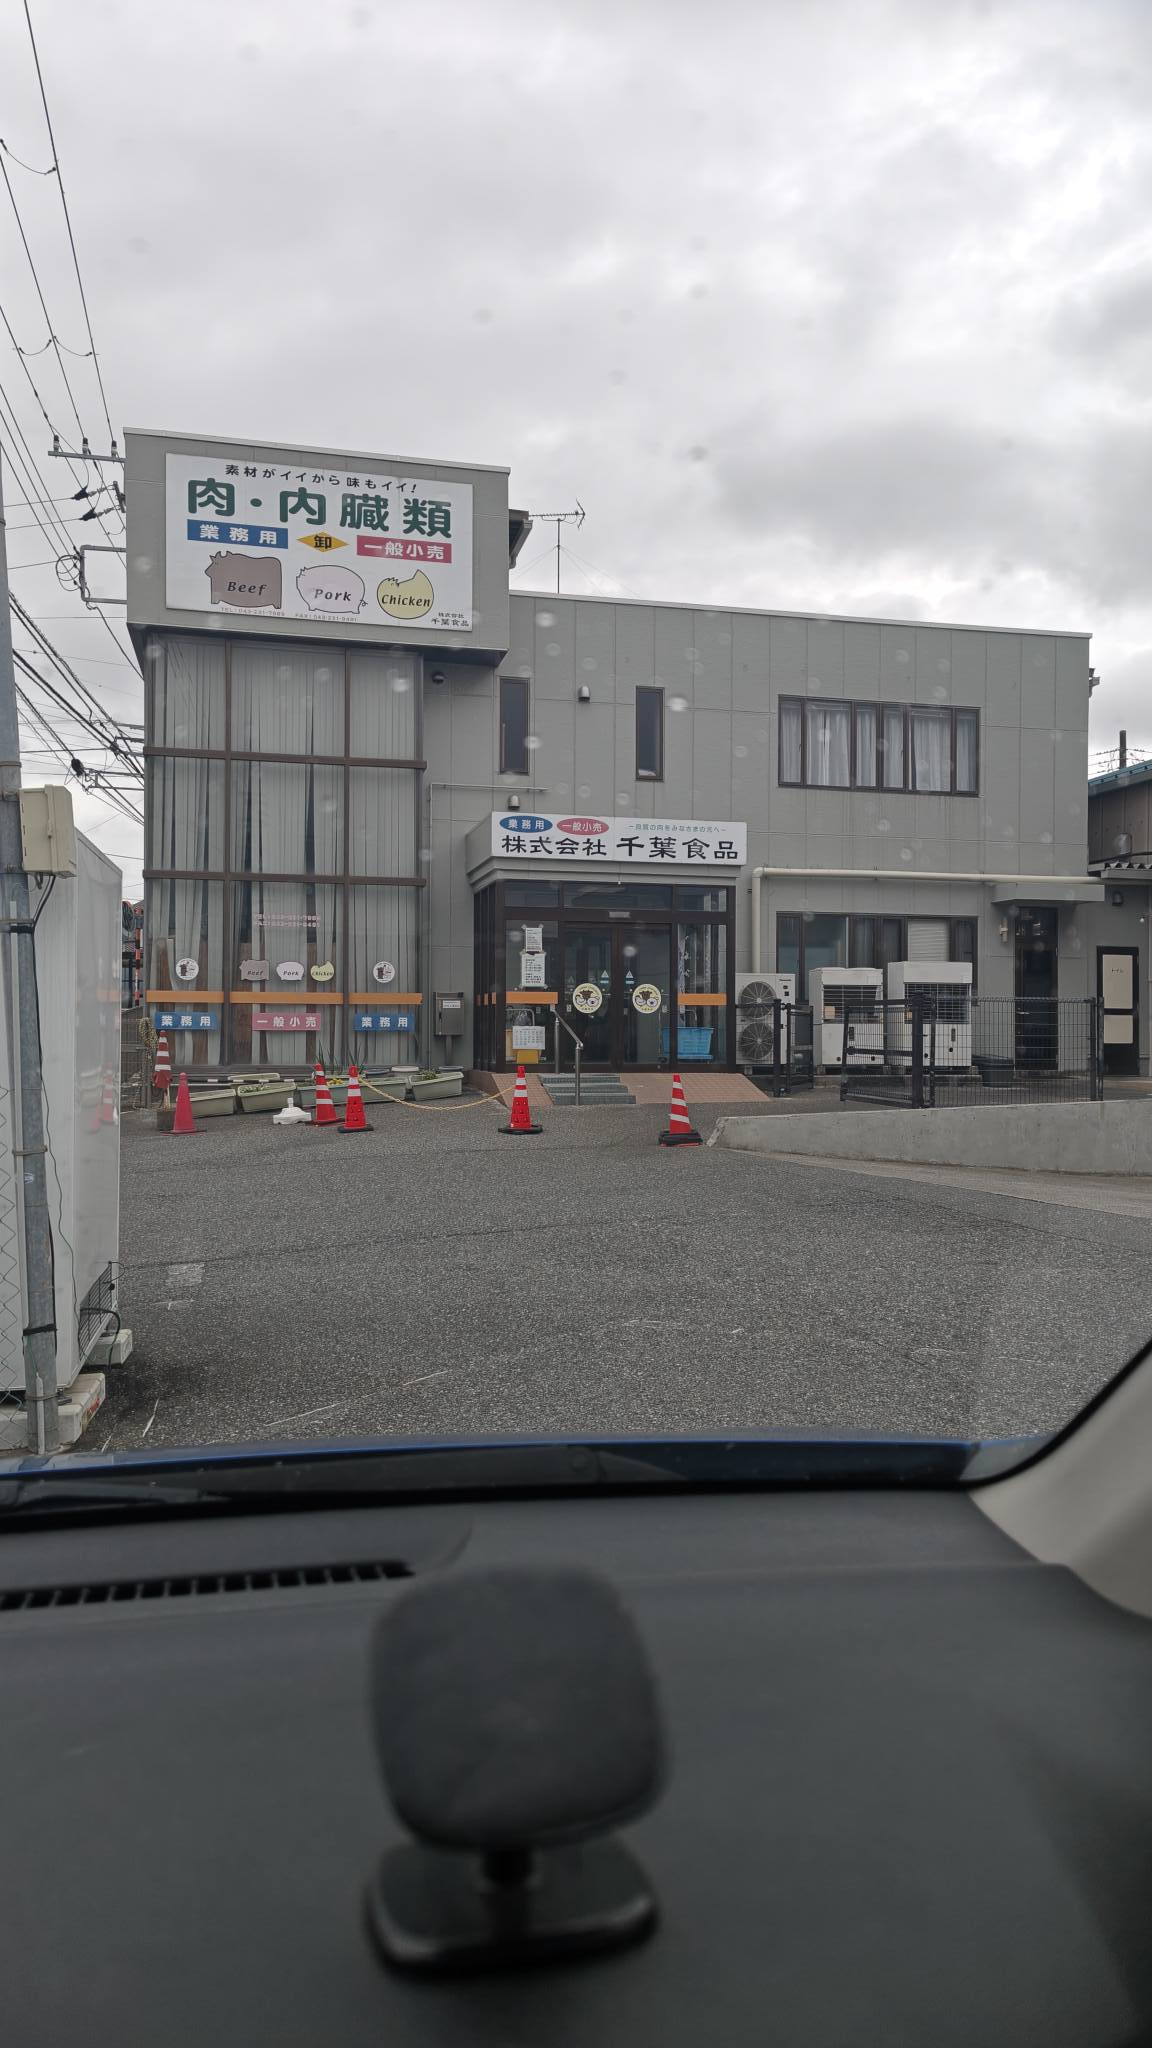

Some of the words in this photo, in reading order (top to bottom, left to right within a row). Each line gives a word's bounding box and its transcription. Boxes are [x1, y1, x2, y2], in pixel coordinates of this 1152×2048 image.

[187, 478, 453, 539] 肉・内臓類
[199, 524, 278, 545] 業務用
[313, 535, 333, 550] 卸
[364, 541, 445, 560] 一般小売
[227, 581, 268, 597] Beef
[314, 588, 353, 602] Pork
[381, 593, 431, 608] Chicken
[431, 617, 470, 627] 千葉食品
[507, 818, 545, 830] 業務用
[562, 821, 602, 833] 一般小売
[160, 1015, 212, 1027] 業務用
[257, 1016, 317, 1028] 一般小売
[360, 1016, 409, 1028] 業務用
